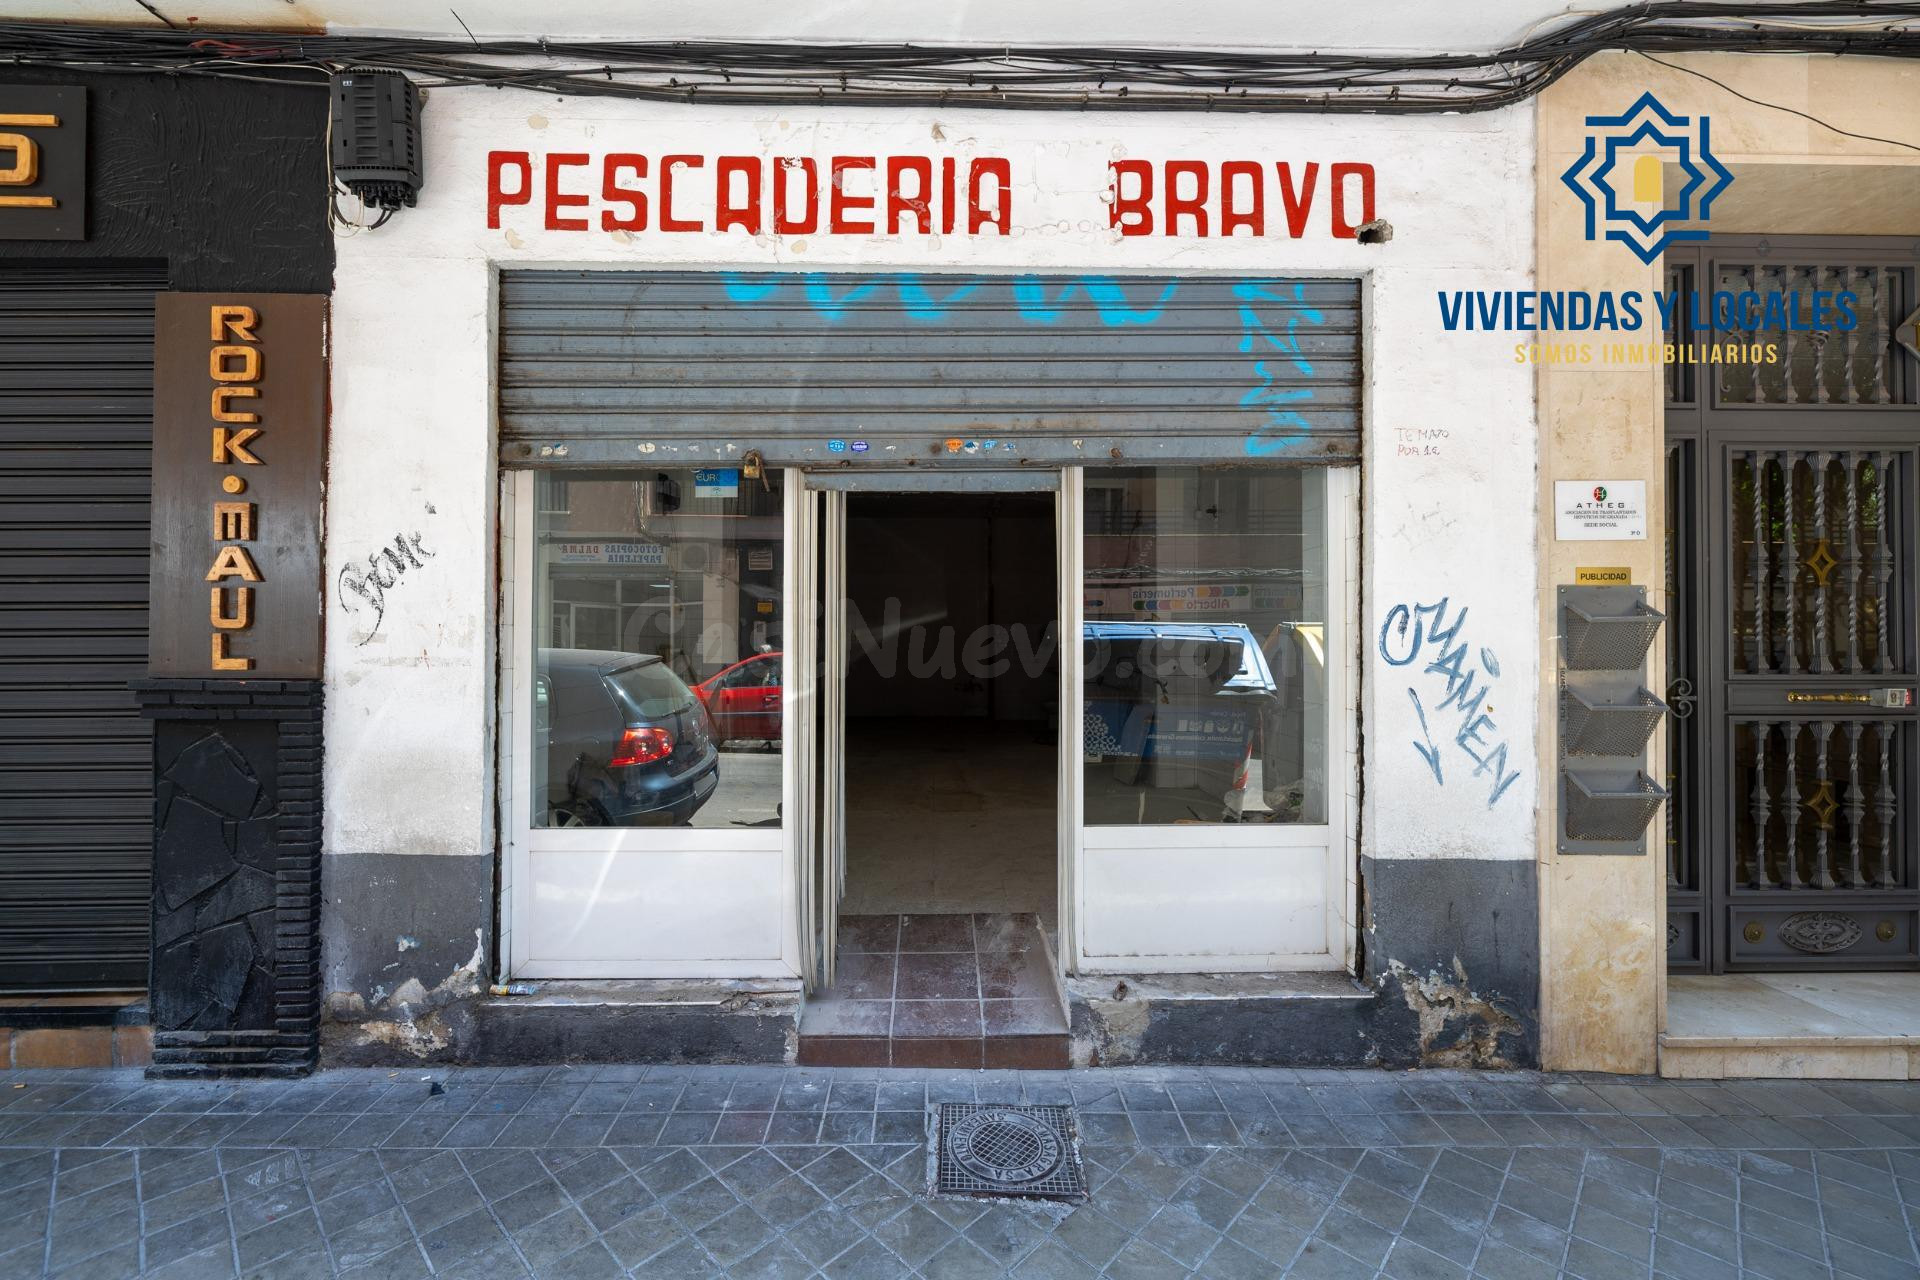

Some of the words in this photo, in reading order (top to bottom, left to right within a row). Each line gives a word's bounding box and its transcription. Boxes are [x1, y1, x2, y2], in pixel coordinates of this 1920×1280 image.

[487, 150, 1012, 236] PESCADERIA
[1107, 159, 1376, 239] BRAVO
[1580, 572, 1627, 581] PUBLICIDAD
